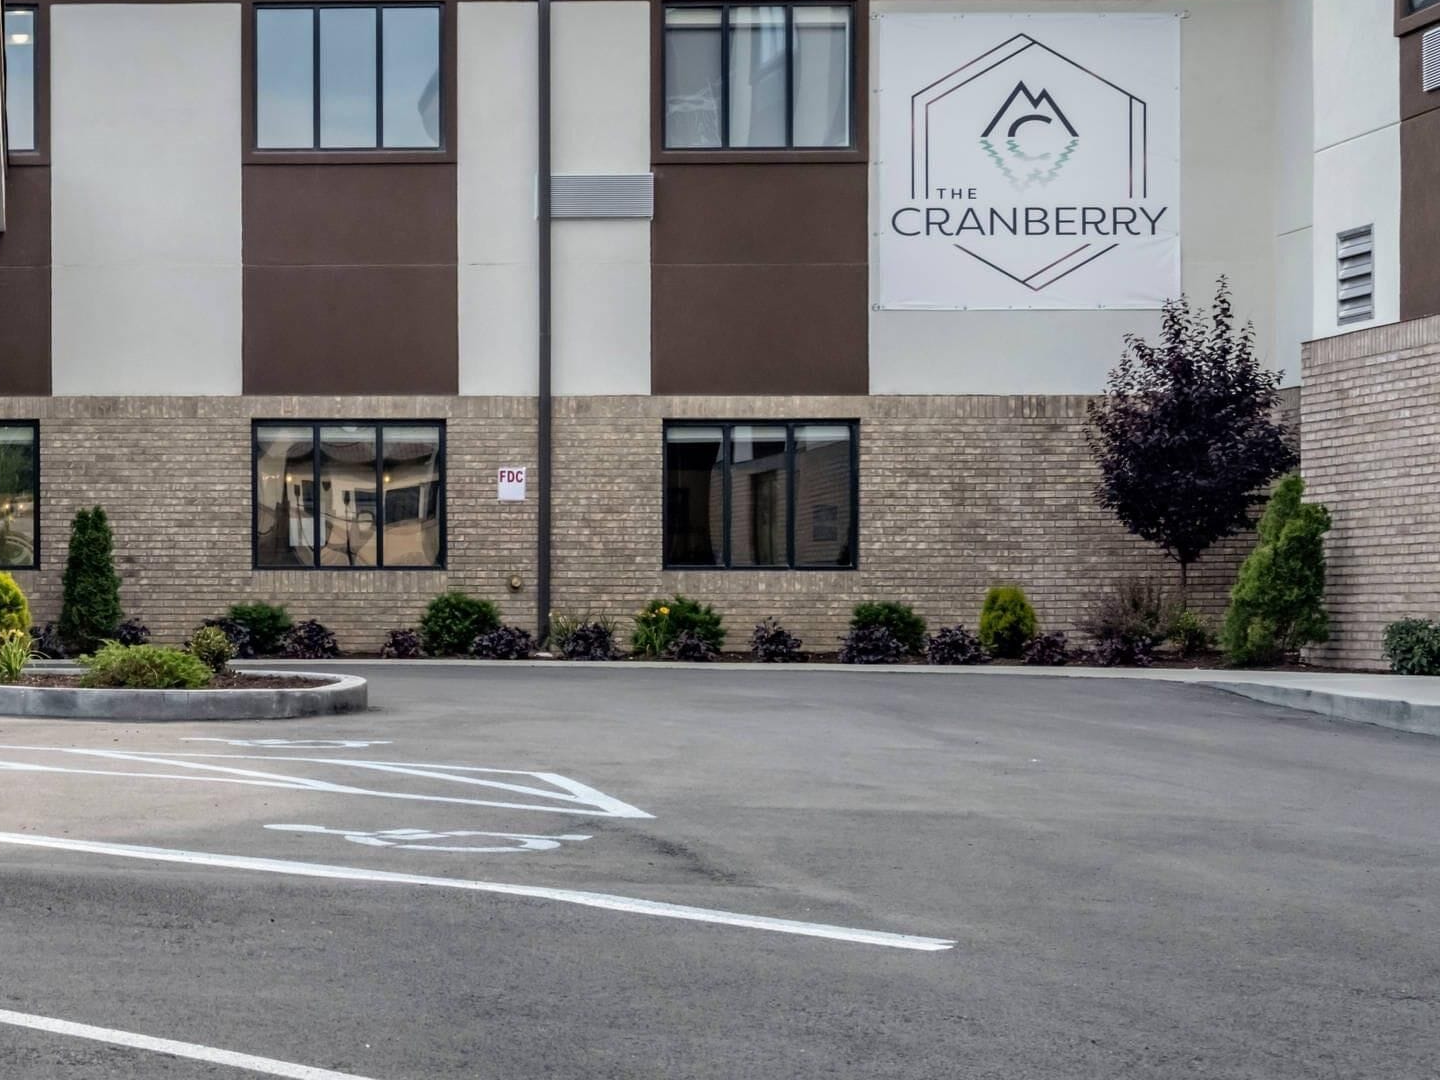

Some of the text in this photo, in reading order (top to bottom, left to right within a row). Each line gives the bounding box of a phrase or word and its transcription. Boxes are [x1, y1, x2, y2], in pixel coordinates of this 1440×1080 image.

[936, 188, 978, 200] THE
[891, 206, 1169, 237] CRANBERRY
[499, 470, 524, 483] FDC
